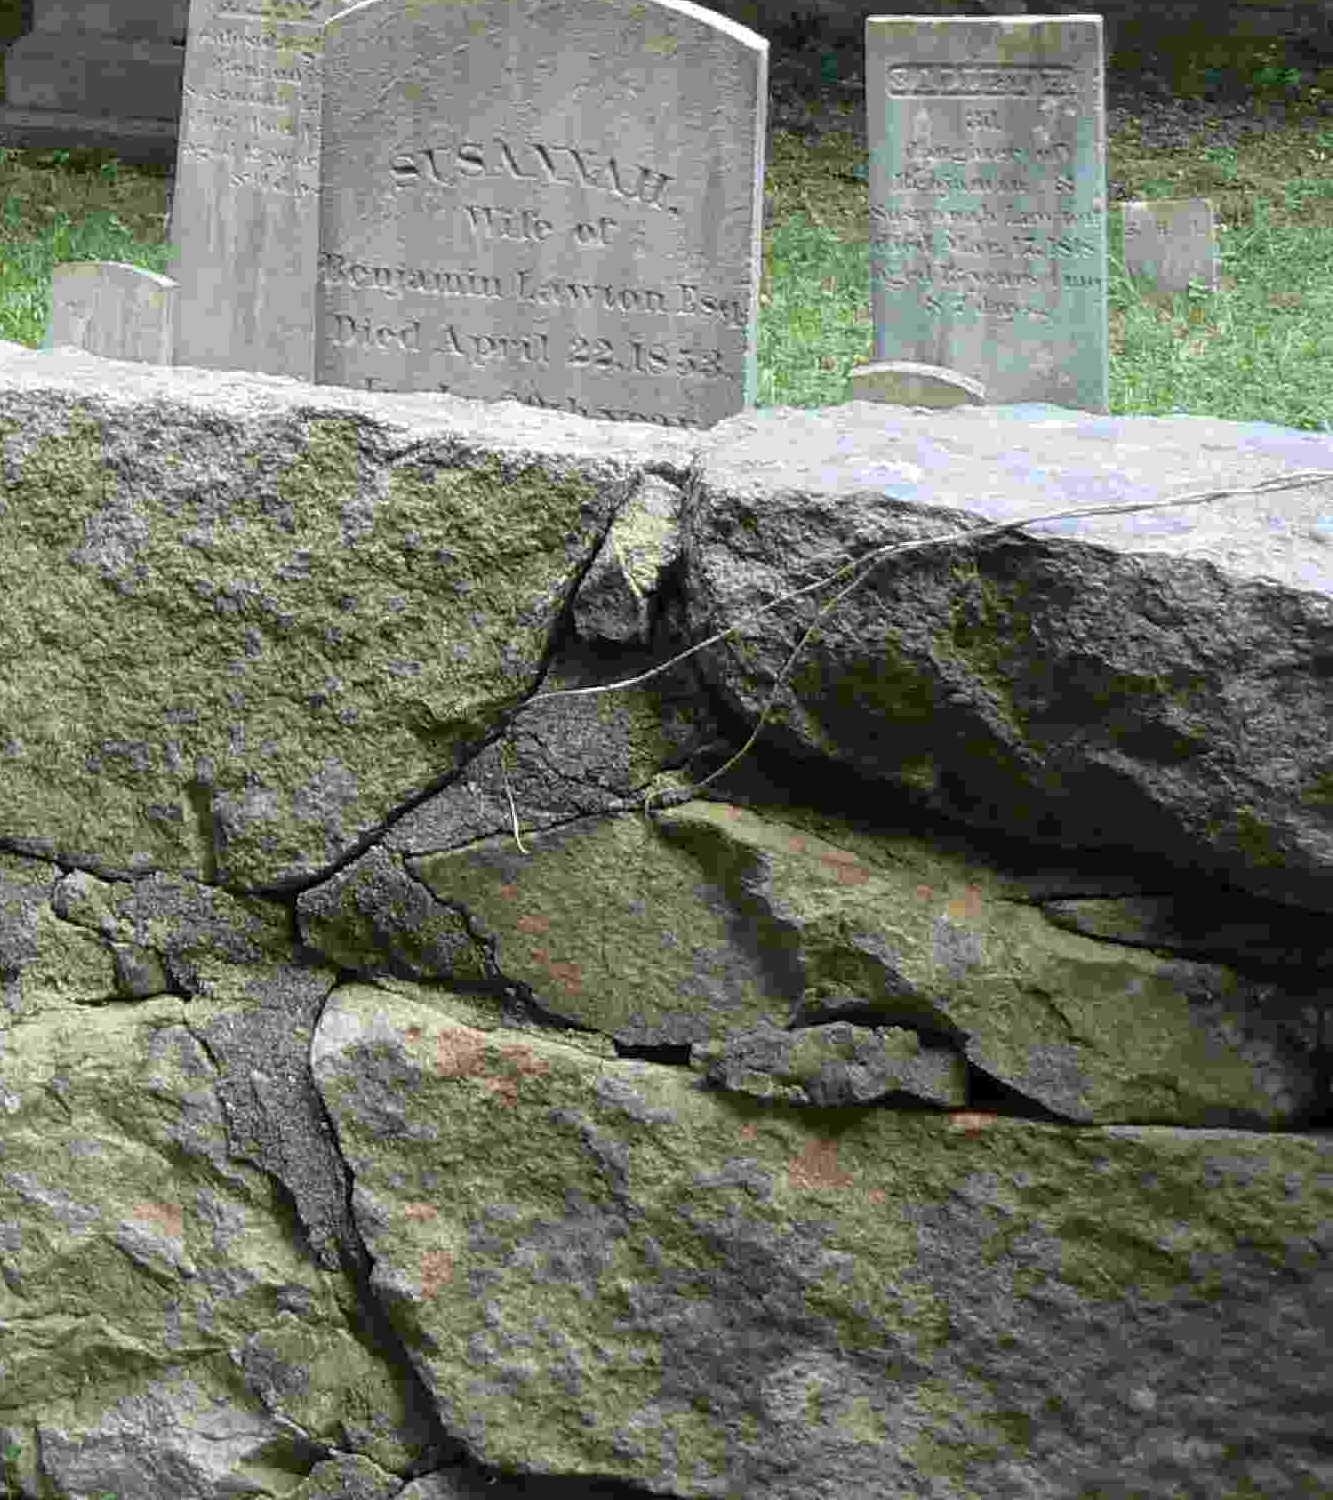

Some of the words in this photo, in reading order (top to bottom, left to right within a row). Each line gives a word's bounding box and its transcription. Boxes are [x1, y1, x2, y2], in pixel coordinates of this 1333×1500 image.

[465, 203, 554, 243] Wife
[321, 252, 502, 301] Benjamin
[333, 314, 422, 354] Died
[434, 324, 550, 371] April
